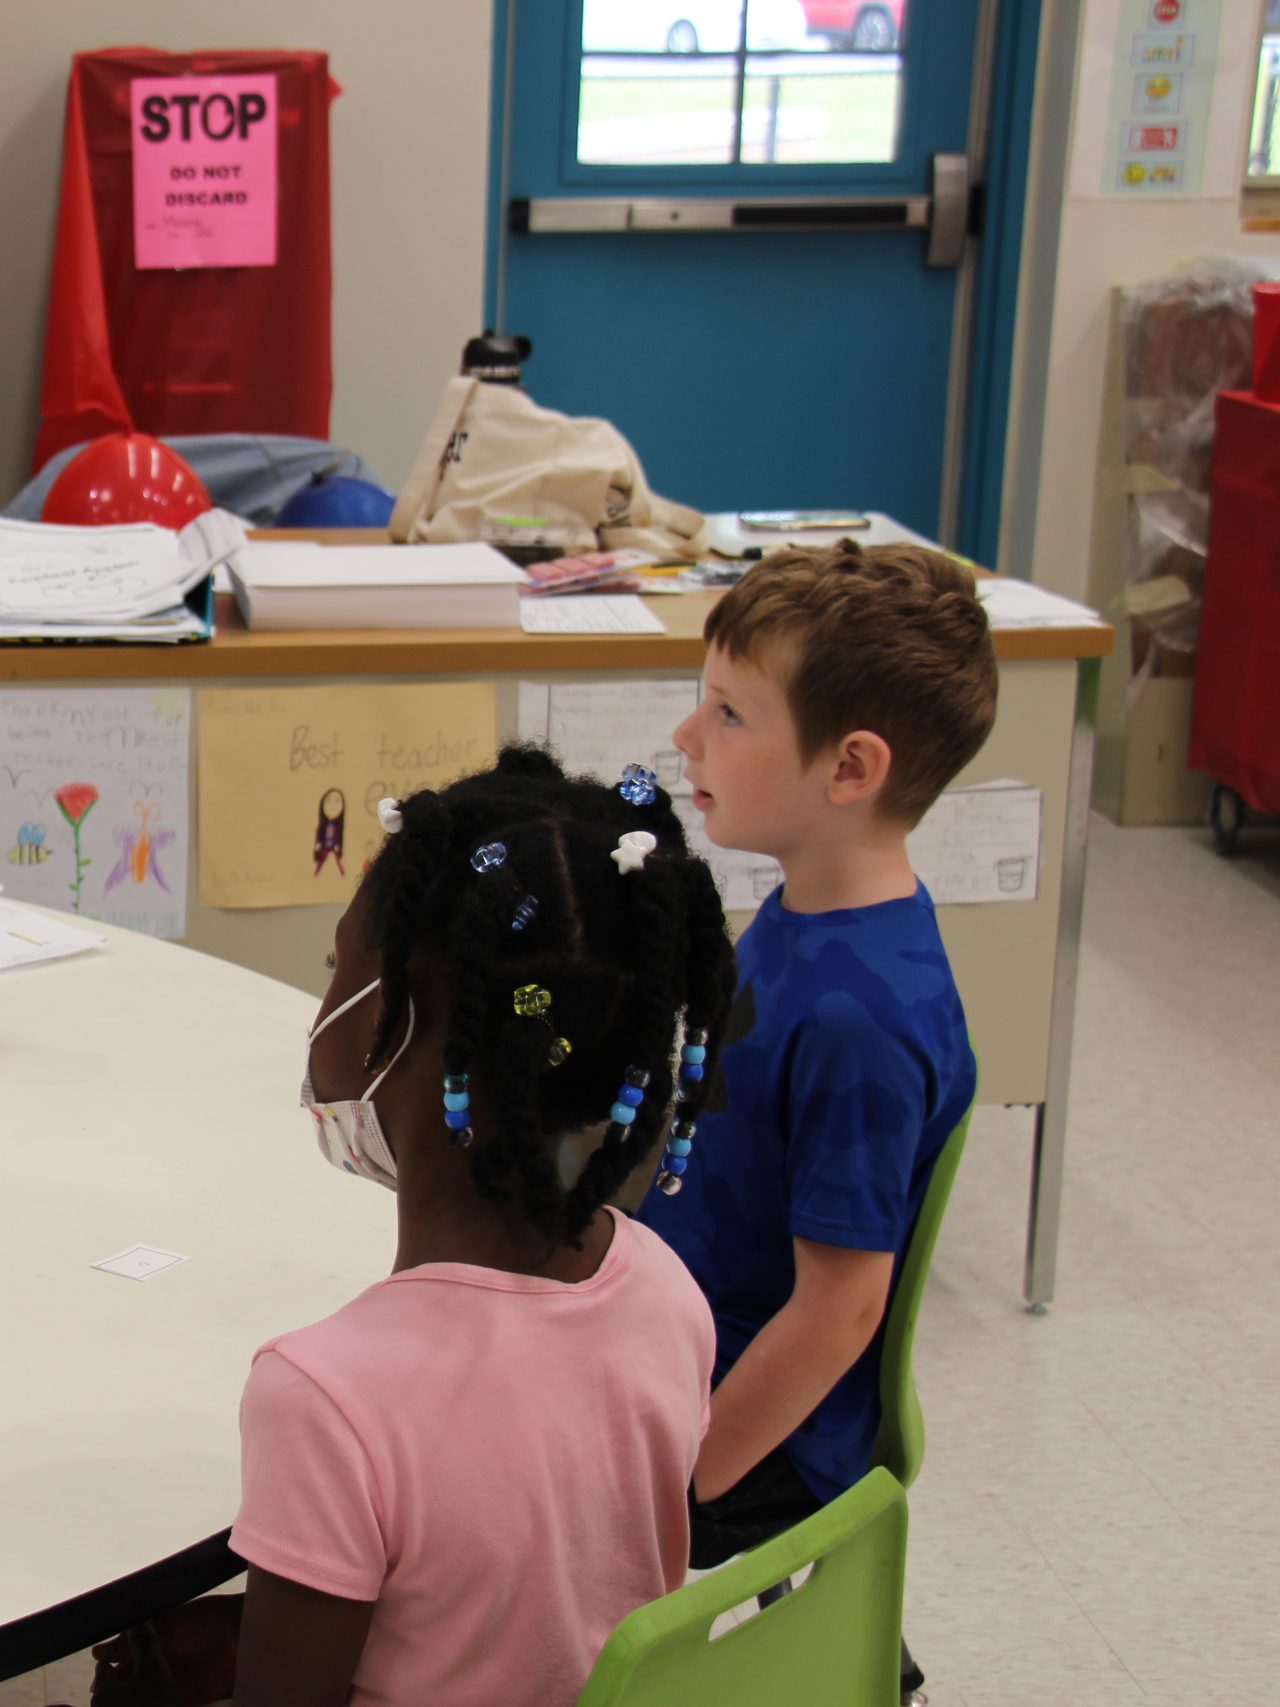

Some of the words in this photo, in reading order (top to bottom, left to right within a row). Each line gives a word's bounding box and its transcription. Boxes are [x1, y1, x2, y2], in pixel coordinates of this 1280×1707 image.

[141, 93, 267, 142] STOP
[171, 166, 197, 180] DO
[203, 165, 242, 180] NOT
[166, 191, 248, 207] DISCARD
[289, 724, 344, 773] Best
[376, 728, 480, 771] teacher
